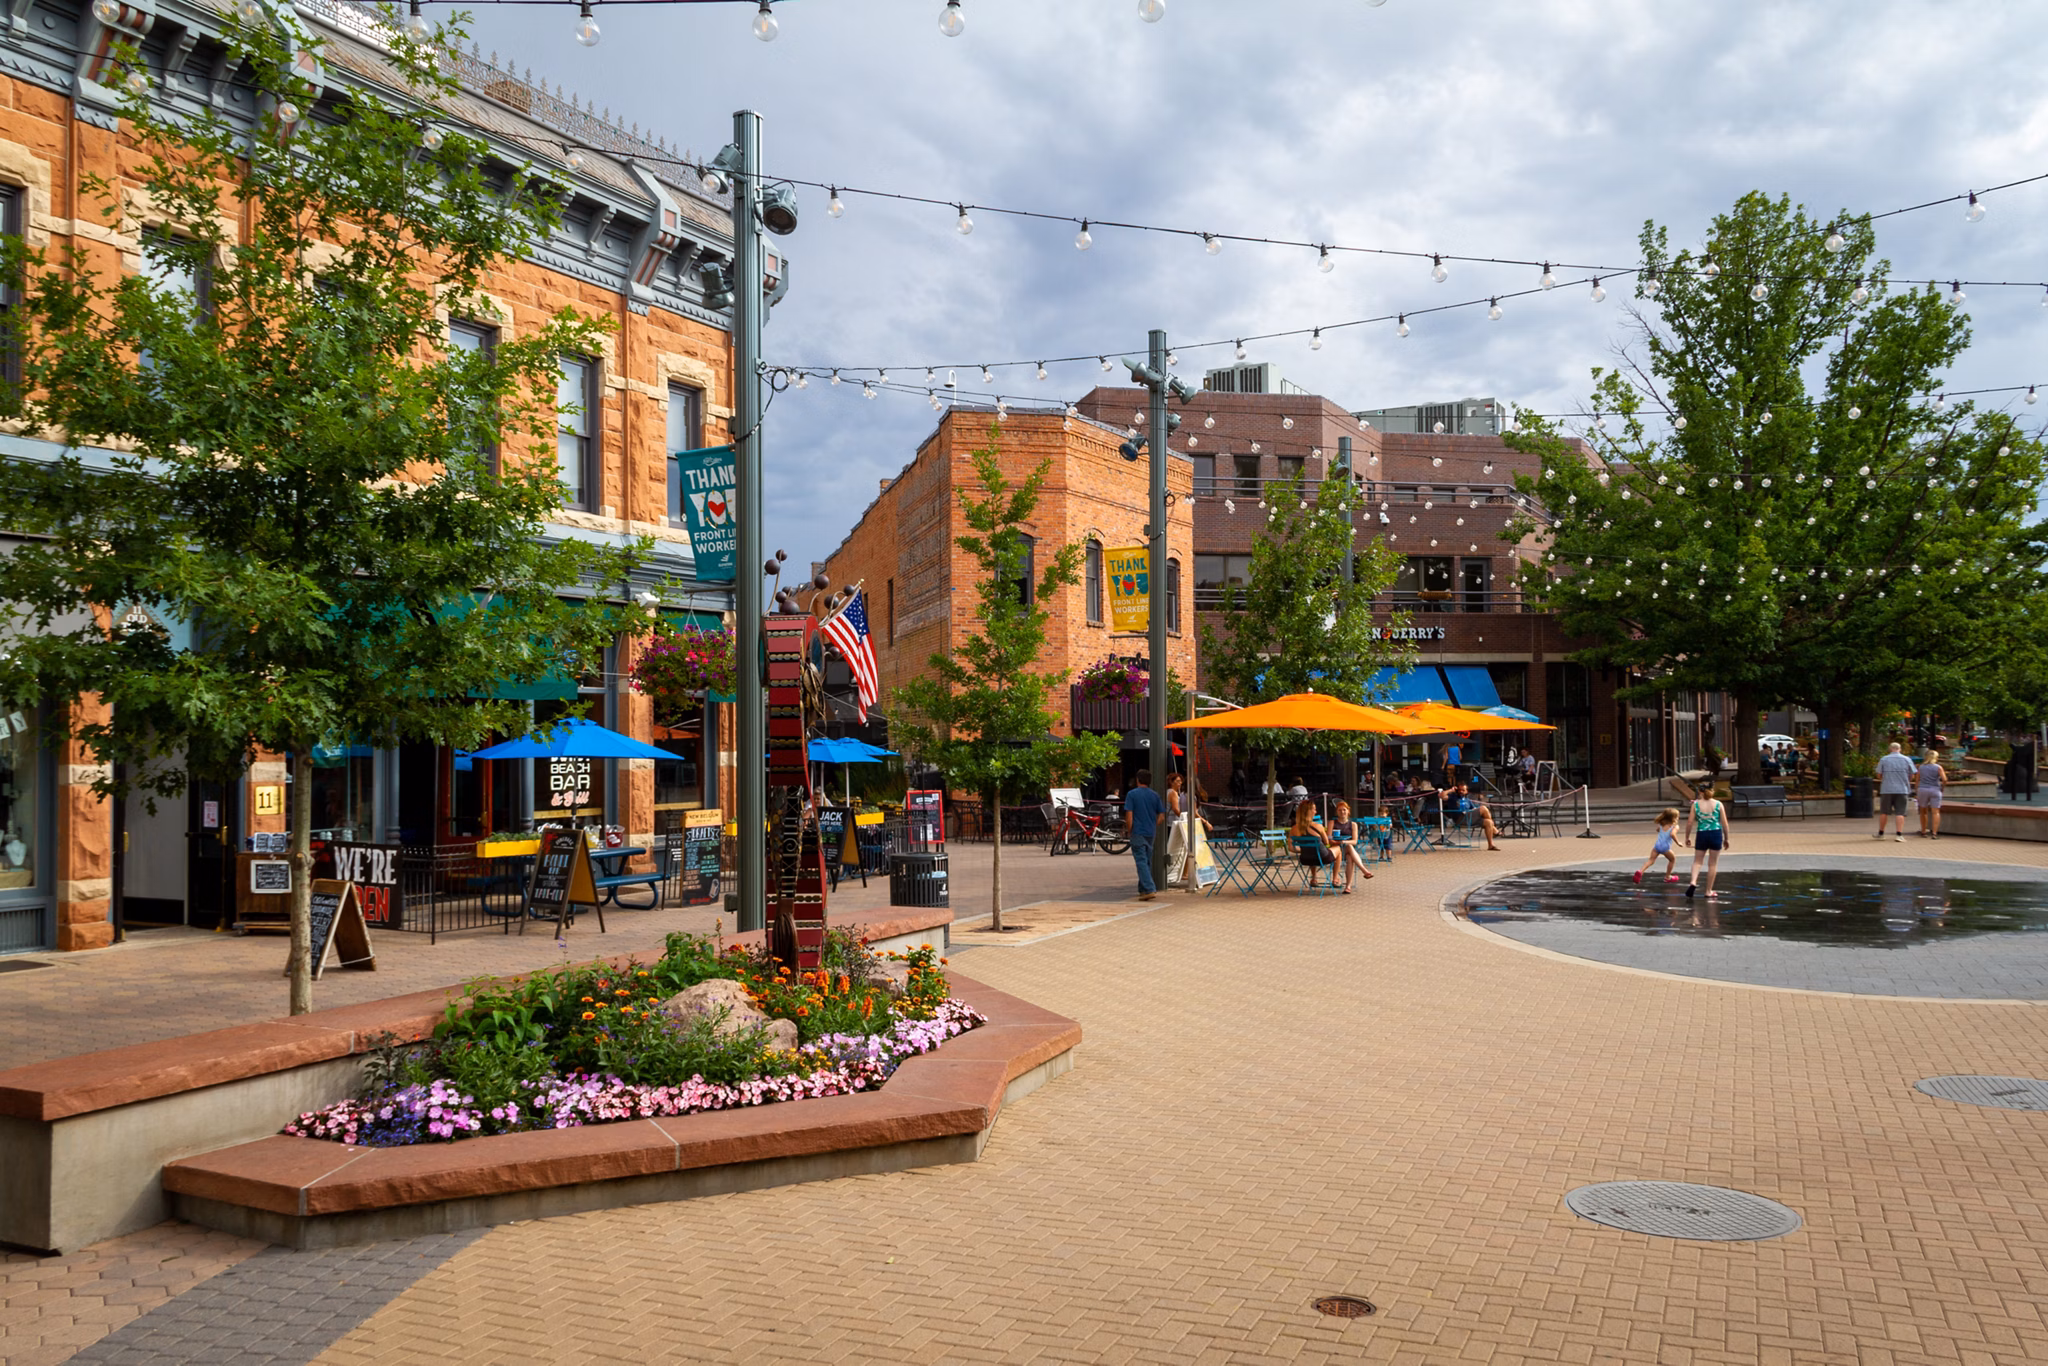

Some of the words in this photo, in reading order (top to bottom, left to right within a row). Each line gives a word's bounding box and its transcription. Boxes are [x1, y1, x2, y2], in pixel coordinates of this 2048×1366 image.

[685, 464, 736, 490] THANK
[693, 529, 725, 542] FRONT
[728, 527, 737, 539] LI
[695, 540, 737, 554] WORKE
[1109, 557, 1147, 573] THANK
[1111, 572, 1149, 597] YOU
[1113, 599, 1134, 607] FRONT
[1114, 606, 1149, 614] WORKERS
[126, 613, 148, 624] OLD
[1392, 626, 1446, 639] JERRY'S
[550, 763, 591, 774] BEACH
[550, 774, 591, 791] BAR
[259, 792, 272, 809] 11
[563, 790, 590, 807] Gill
[819, 811, 844, 822] JACK
[333, 845, 398, 885] WE'RE
[354, 885, 389, 922] PEN
